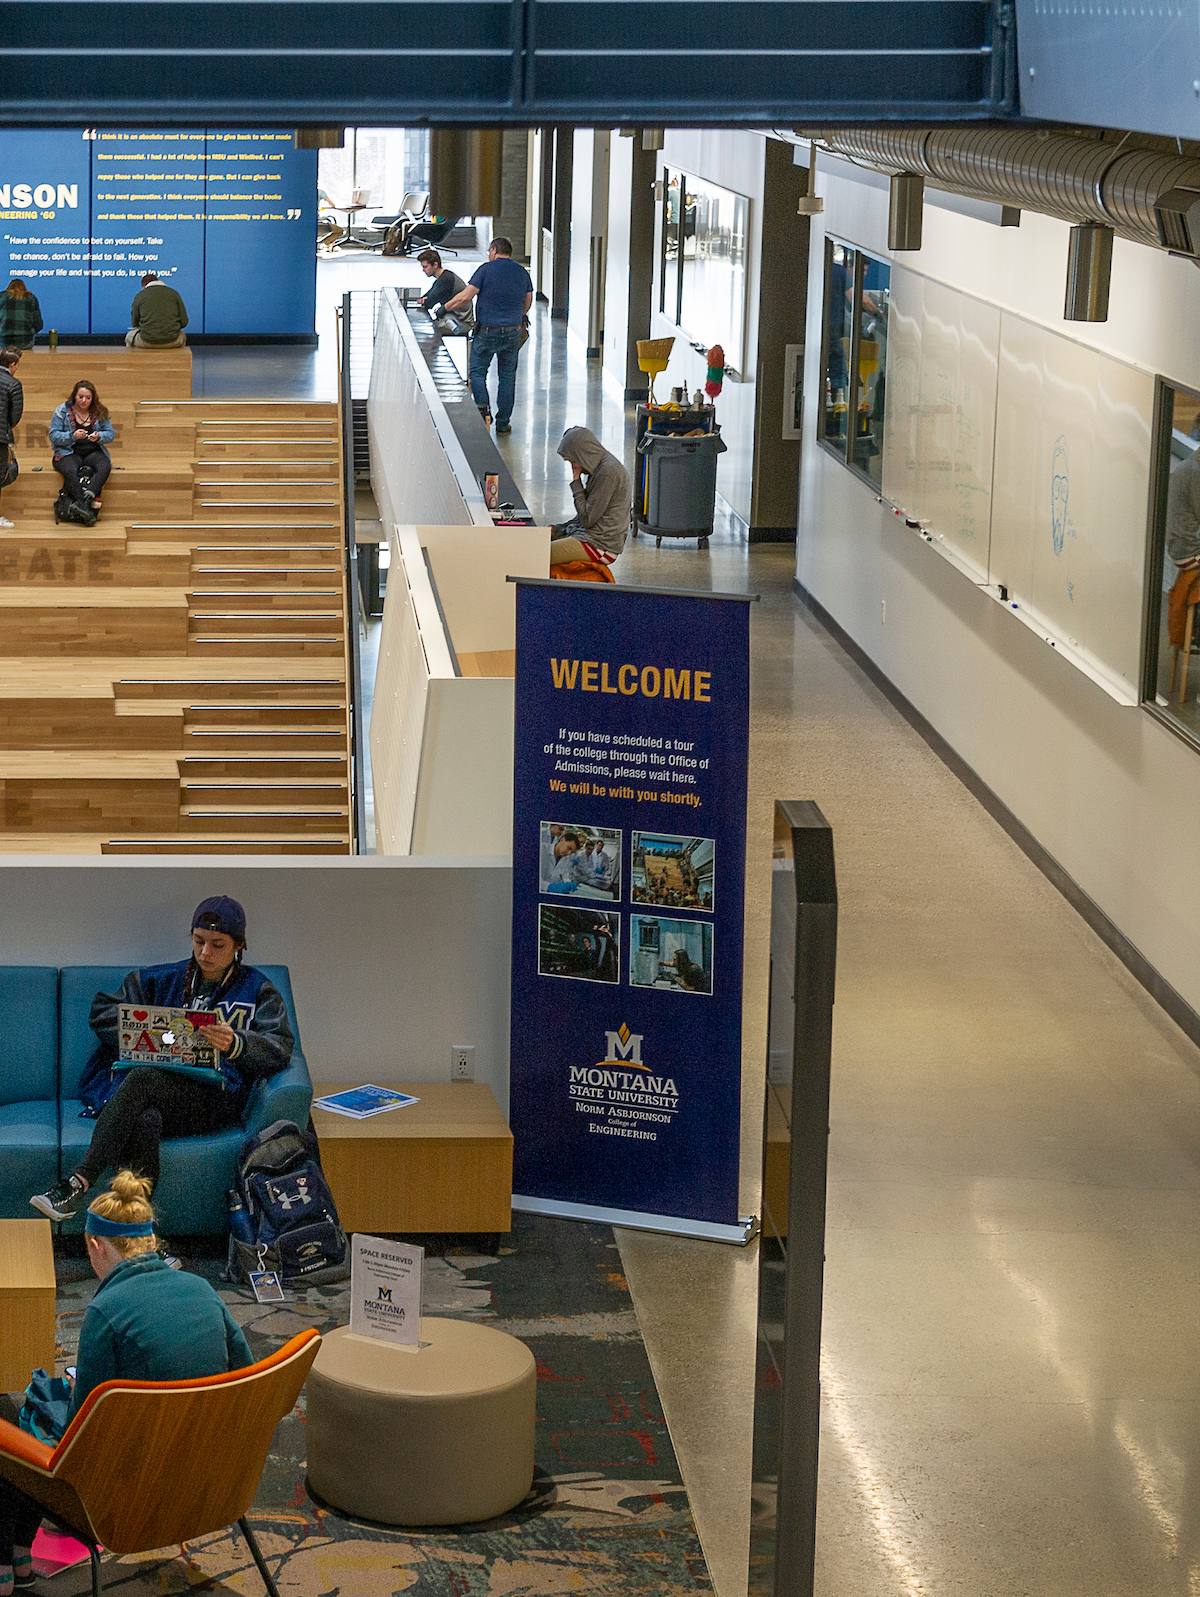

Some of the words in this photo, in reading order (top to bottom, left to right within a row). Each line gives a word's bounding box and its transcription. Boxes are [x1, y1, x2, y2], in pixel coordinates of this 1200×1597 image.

[29, 237, 41, 245] the
[42, 237, 81, 245] confidence
[81, 237, 90, 245] to
[91, 237, 104, 245] bet
[104, 237, 113, 245] on
[115, 237, 145, 246] yourself.
[146, 237, 163, 245] Take
[9, 253, 22, 261] the
[22, 253, 51, 262] chance,
[52, 253, 70, 261] don't
[72, 253, 81, 261] be
[82, 253, 103, 261] afraid
[104, 253, 112, 261] to
[128, 253, 144, 261] How
[144, 253, 159, 262] you
[9, 269, 38, 278] manage
[39, 269, 55, 278] your
[102, 269, 115, 278] you
[137, 269, 147, 278] up
[550, 658, 712, 702] WELCOME
[559, 728, 567, 739] If
[568, 731, 585, 743] you
[588, 731, 611, 744] have
[612, 735, 663, 749] scheduled
[665, 741, 672, 749] a
[674, 740, 695, 751] tour
[544, 743, 554, 753] of
[555, 744, 571, 755] the
[573, 747, 608, 760] college
[609, 750, 648, 765] through
[650, 754, 666, 765] the
[668, 755, 697, 768] Office
[699, 758, 710, 769] of
[554, 760, 613, 778] Admissions,
[614, 767, 647, 779] please
[649, 770, 670, 781] wait
[672, 773, 697, 784] here.
[550, 779, 567, 791] We
[570, 782, 590, 794] will
[593, 784, 606, 795] be
[609, 786, 634, 799] with
[637, 790, 658, 802] you
[660, 791, 702, 808] shortly.
[604, 1031, 644, 1066] M
[569, 1066, 679, 1096] MONTANA
[569, 1084, 604, 1099] STATE
[608, 1090, 679, 1108] UNIVERSITY
[589, 1123, 657, 1141] ENGINEERING
[608, 1119, 630, 1127] College
[360, 1248, 379, 1258] SPACE
[381, 1252, 413, 1265] RESERVED
[378, 1286, 392, 1302] M
[364, 1300, 406, 1315] MONTANA
